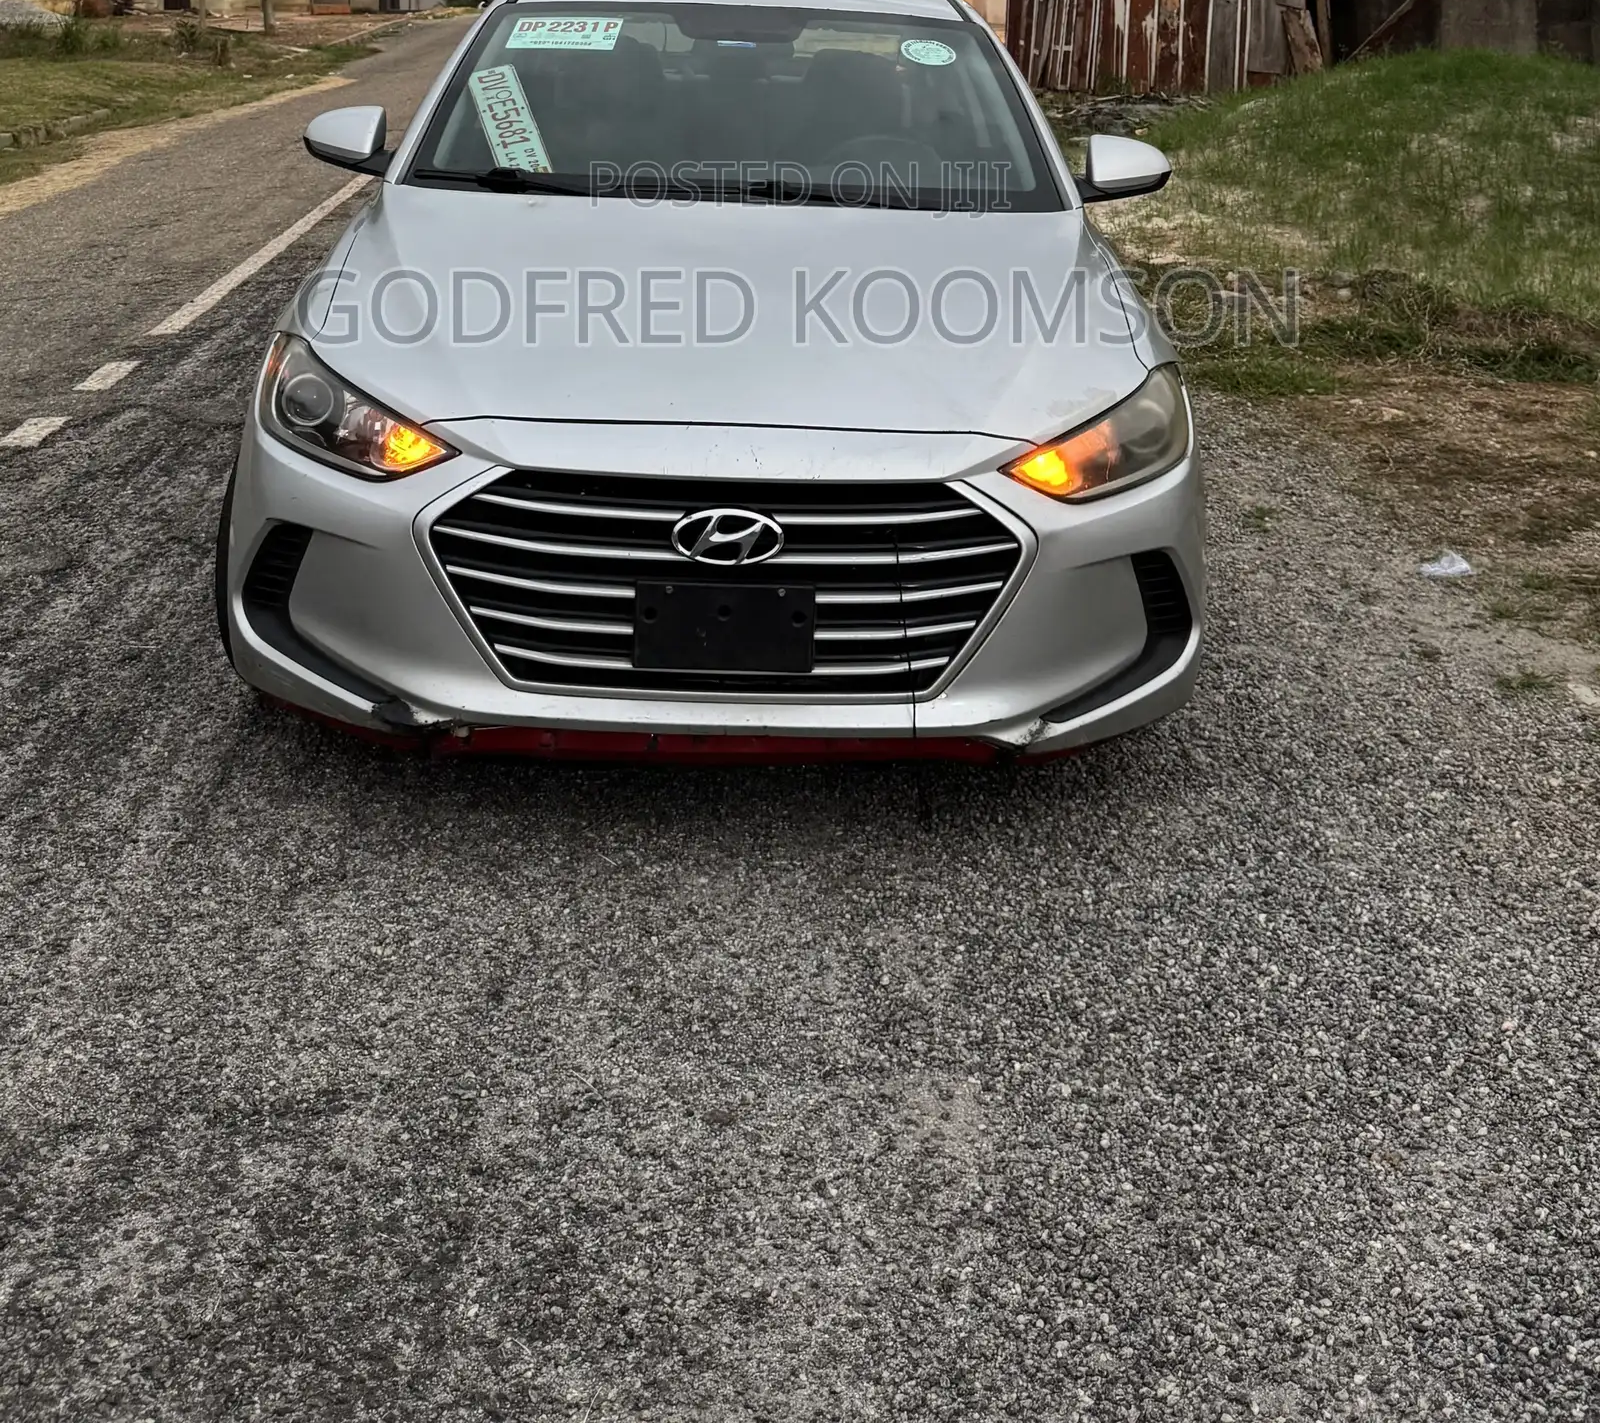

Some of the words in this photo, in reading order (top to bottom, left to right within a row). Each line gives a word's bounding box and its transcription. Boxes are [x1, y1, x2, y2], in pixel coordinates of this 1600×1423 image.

[518, 21, 547, 32] DP
[547, 21, 600, 32] 2231
[603, 21, 619, 32] P
